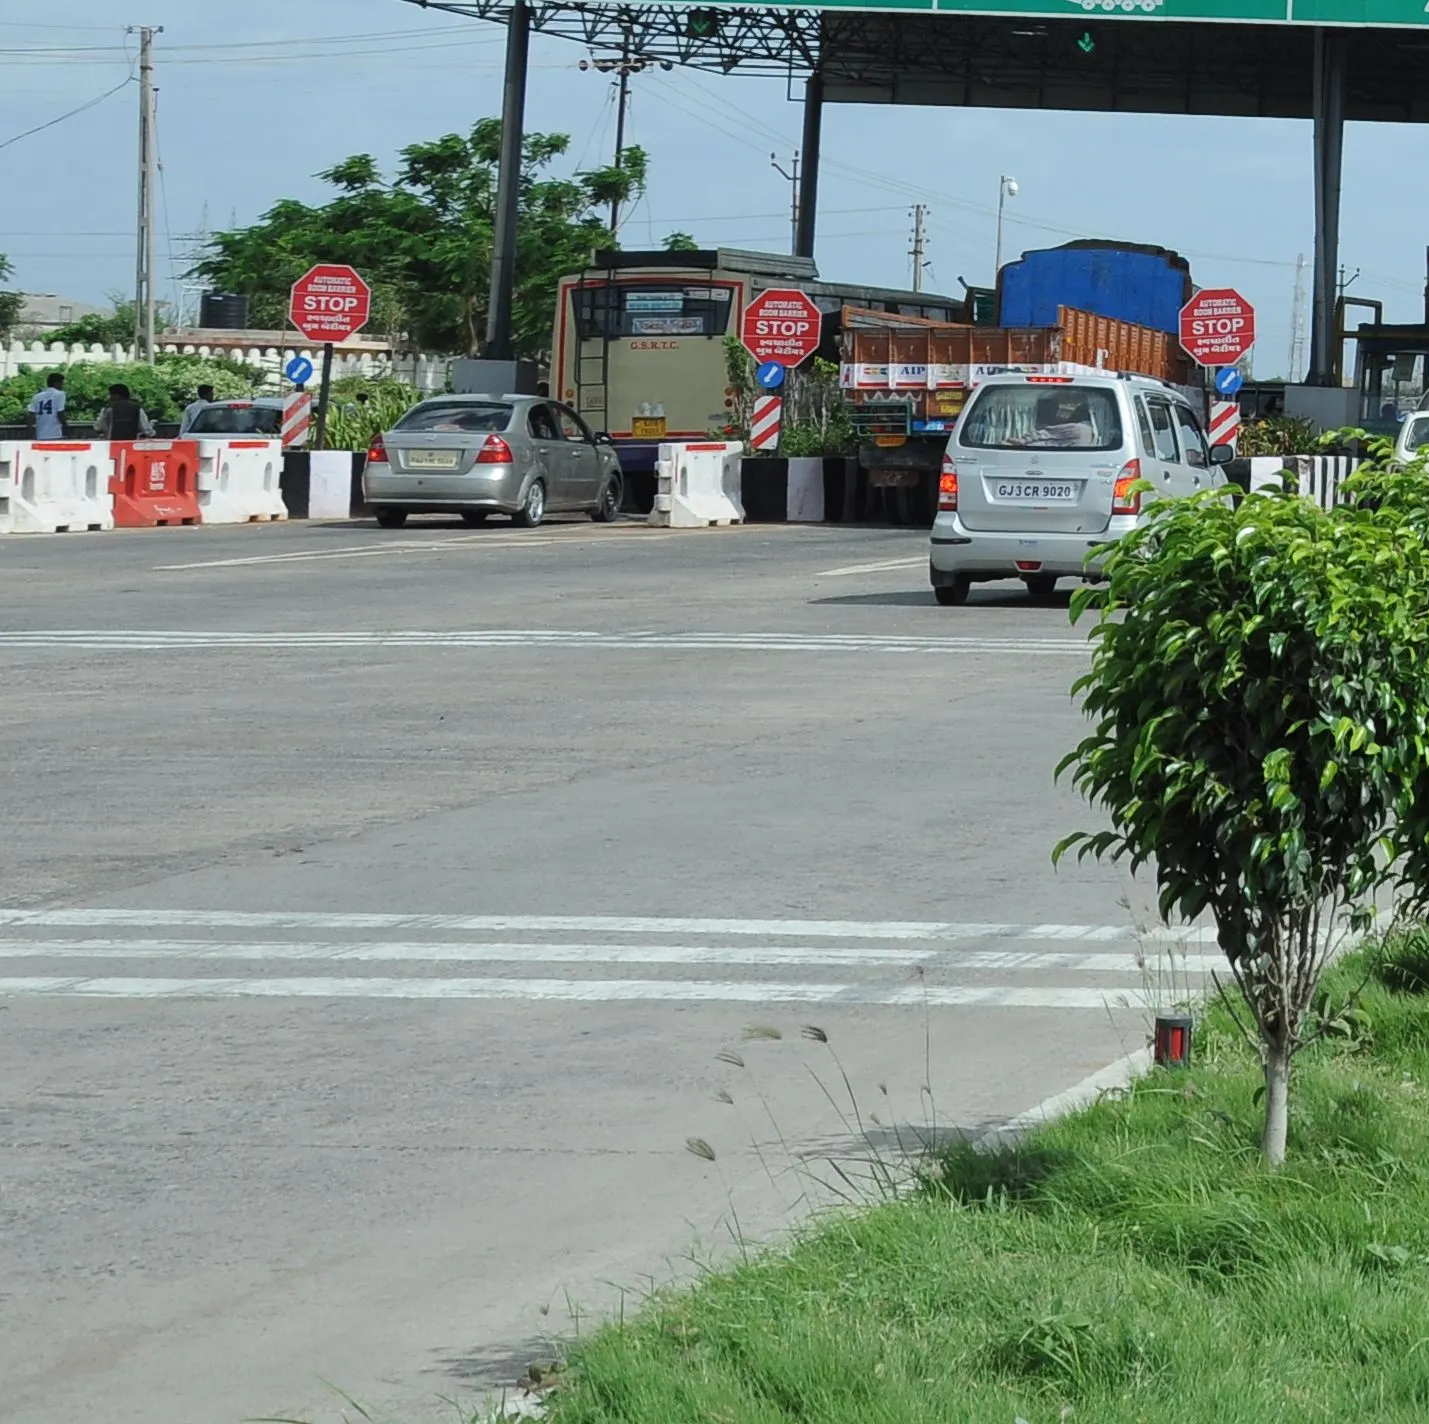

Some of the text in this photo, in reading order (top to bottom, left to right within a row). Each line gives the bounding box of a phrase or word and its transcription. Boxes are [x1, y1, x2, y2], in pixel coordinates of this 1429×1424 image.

[303, 296, 358, 311] STOP
[755, 320, 809, 336] STOP
[1192, 318, 1244, 335] STOP
[38, 399, 53, 415] 14
[1043, 486, 1071, 497] 9020
